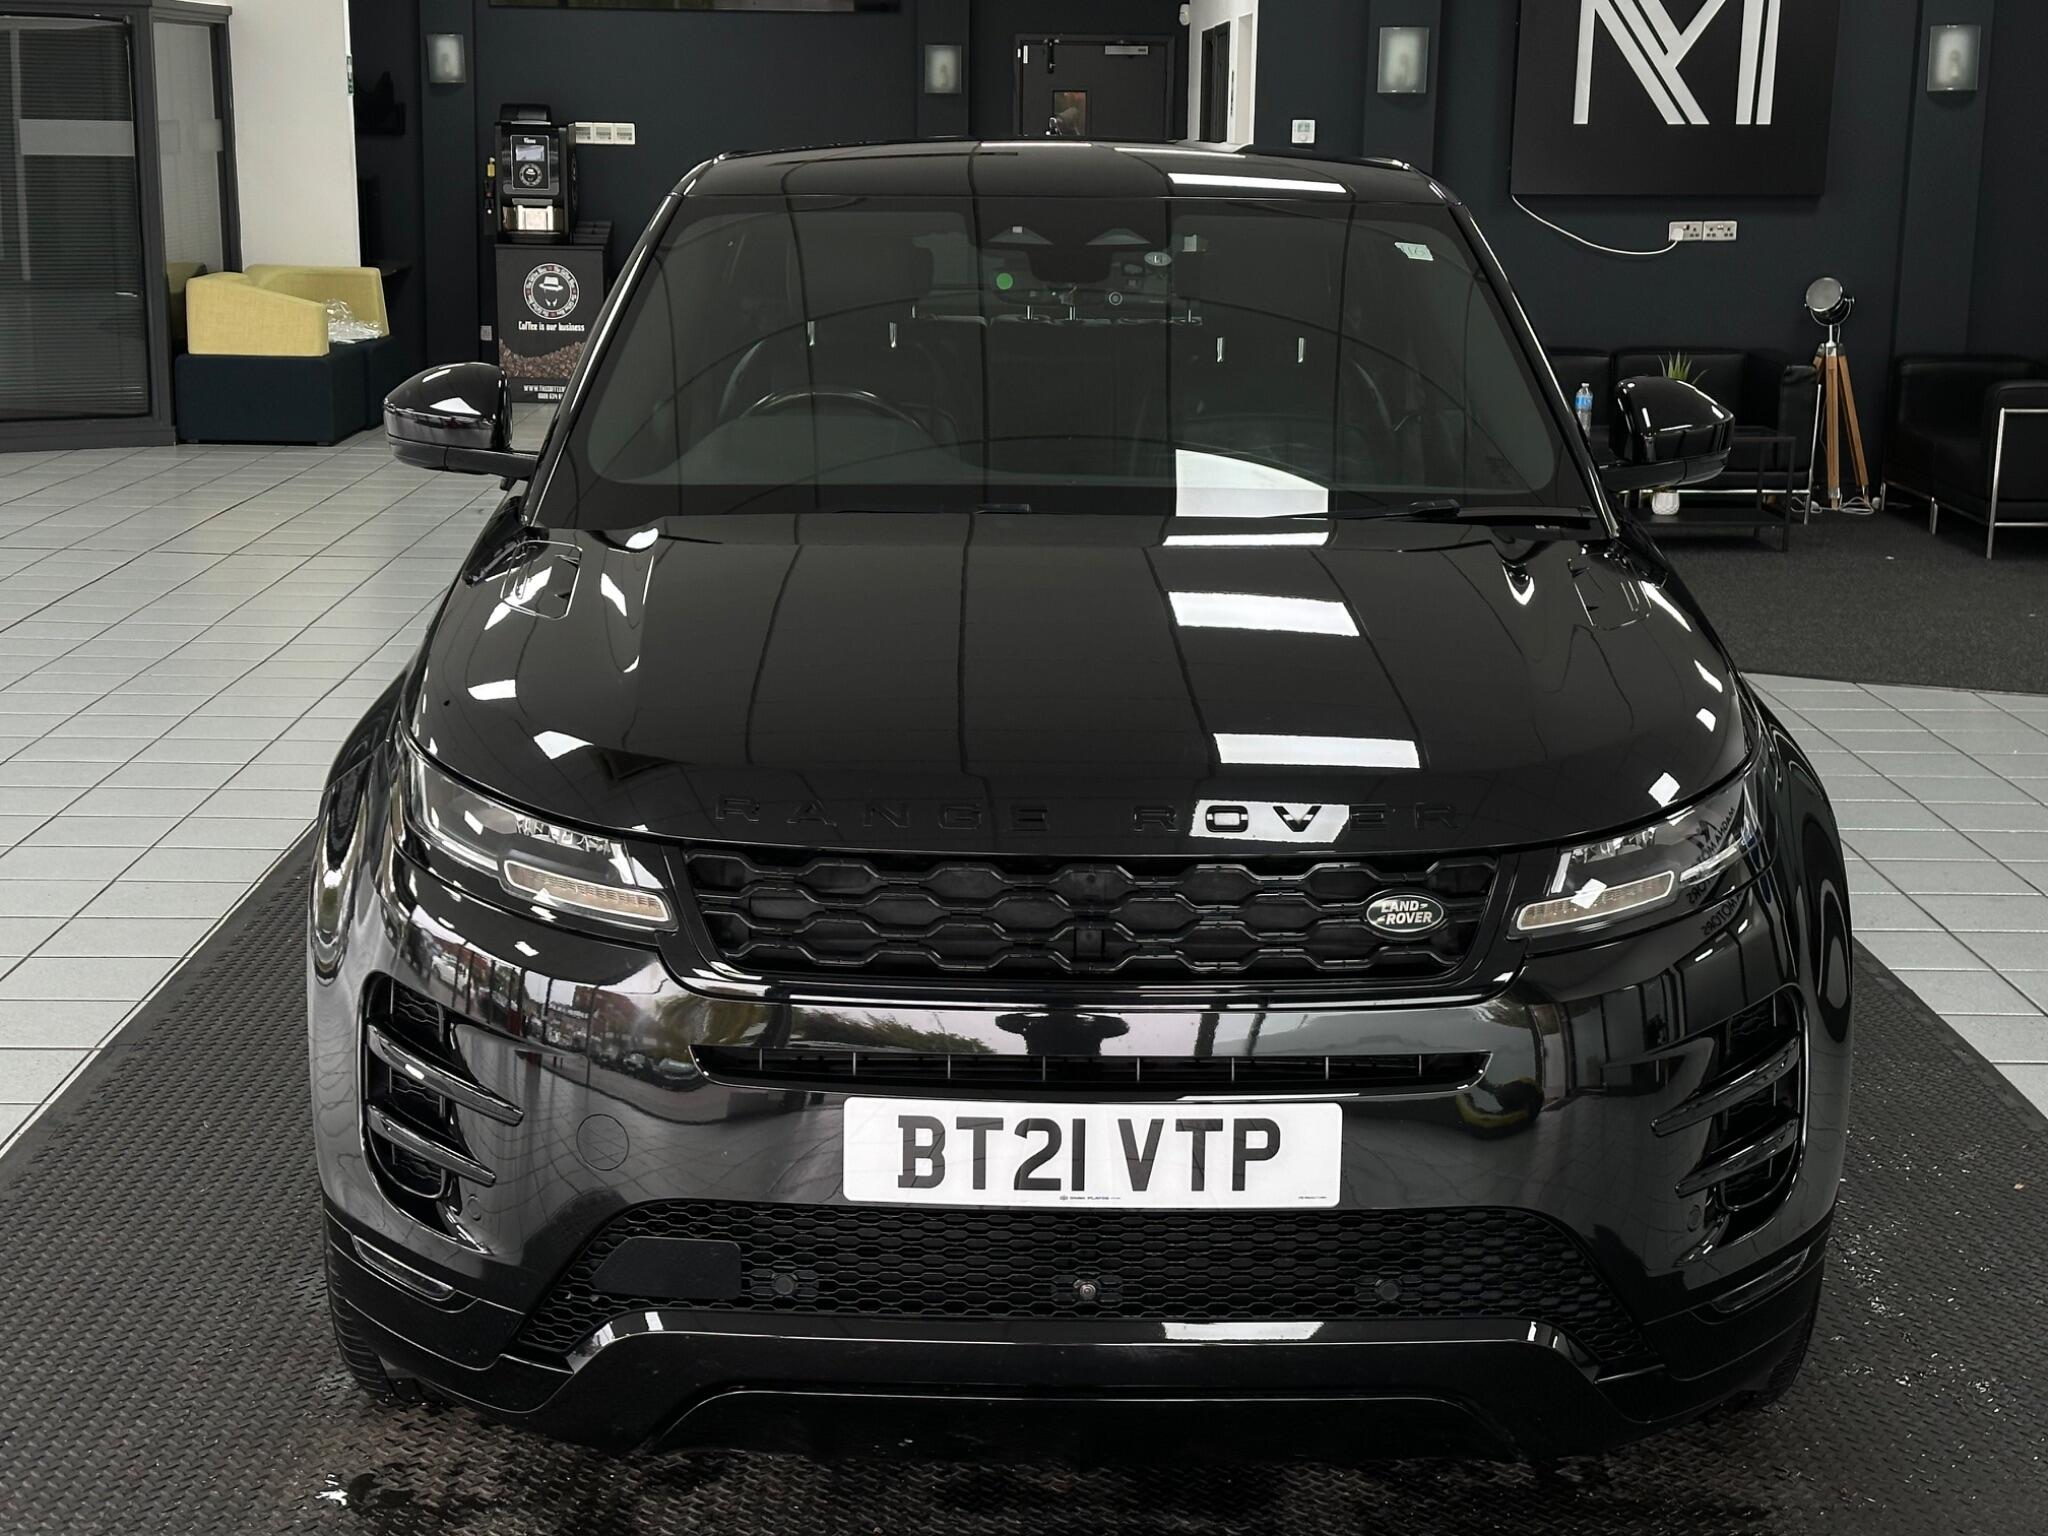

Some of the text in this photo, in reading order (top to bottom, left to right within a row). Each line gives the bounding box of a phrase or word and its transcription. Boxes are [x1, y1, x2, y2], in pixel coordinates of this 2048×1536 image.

[518, 320, 538, 330] Coffee
[546, 323, 557, 331] our
[558, 322, 585, 331] business
[714, 797, 1461, 835] RANGE ROVER
[1381, 900, 1420, 913] LAND
[1386, 911, 1433, 925] ROVER
[897, 1115, 1281, 1193] BT21 VTP
